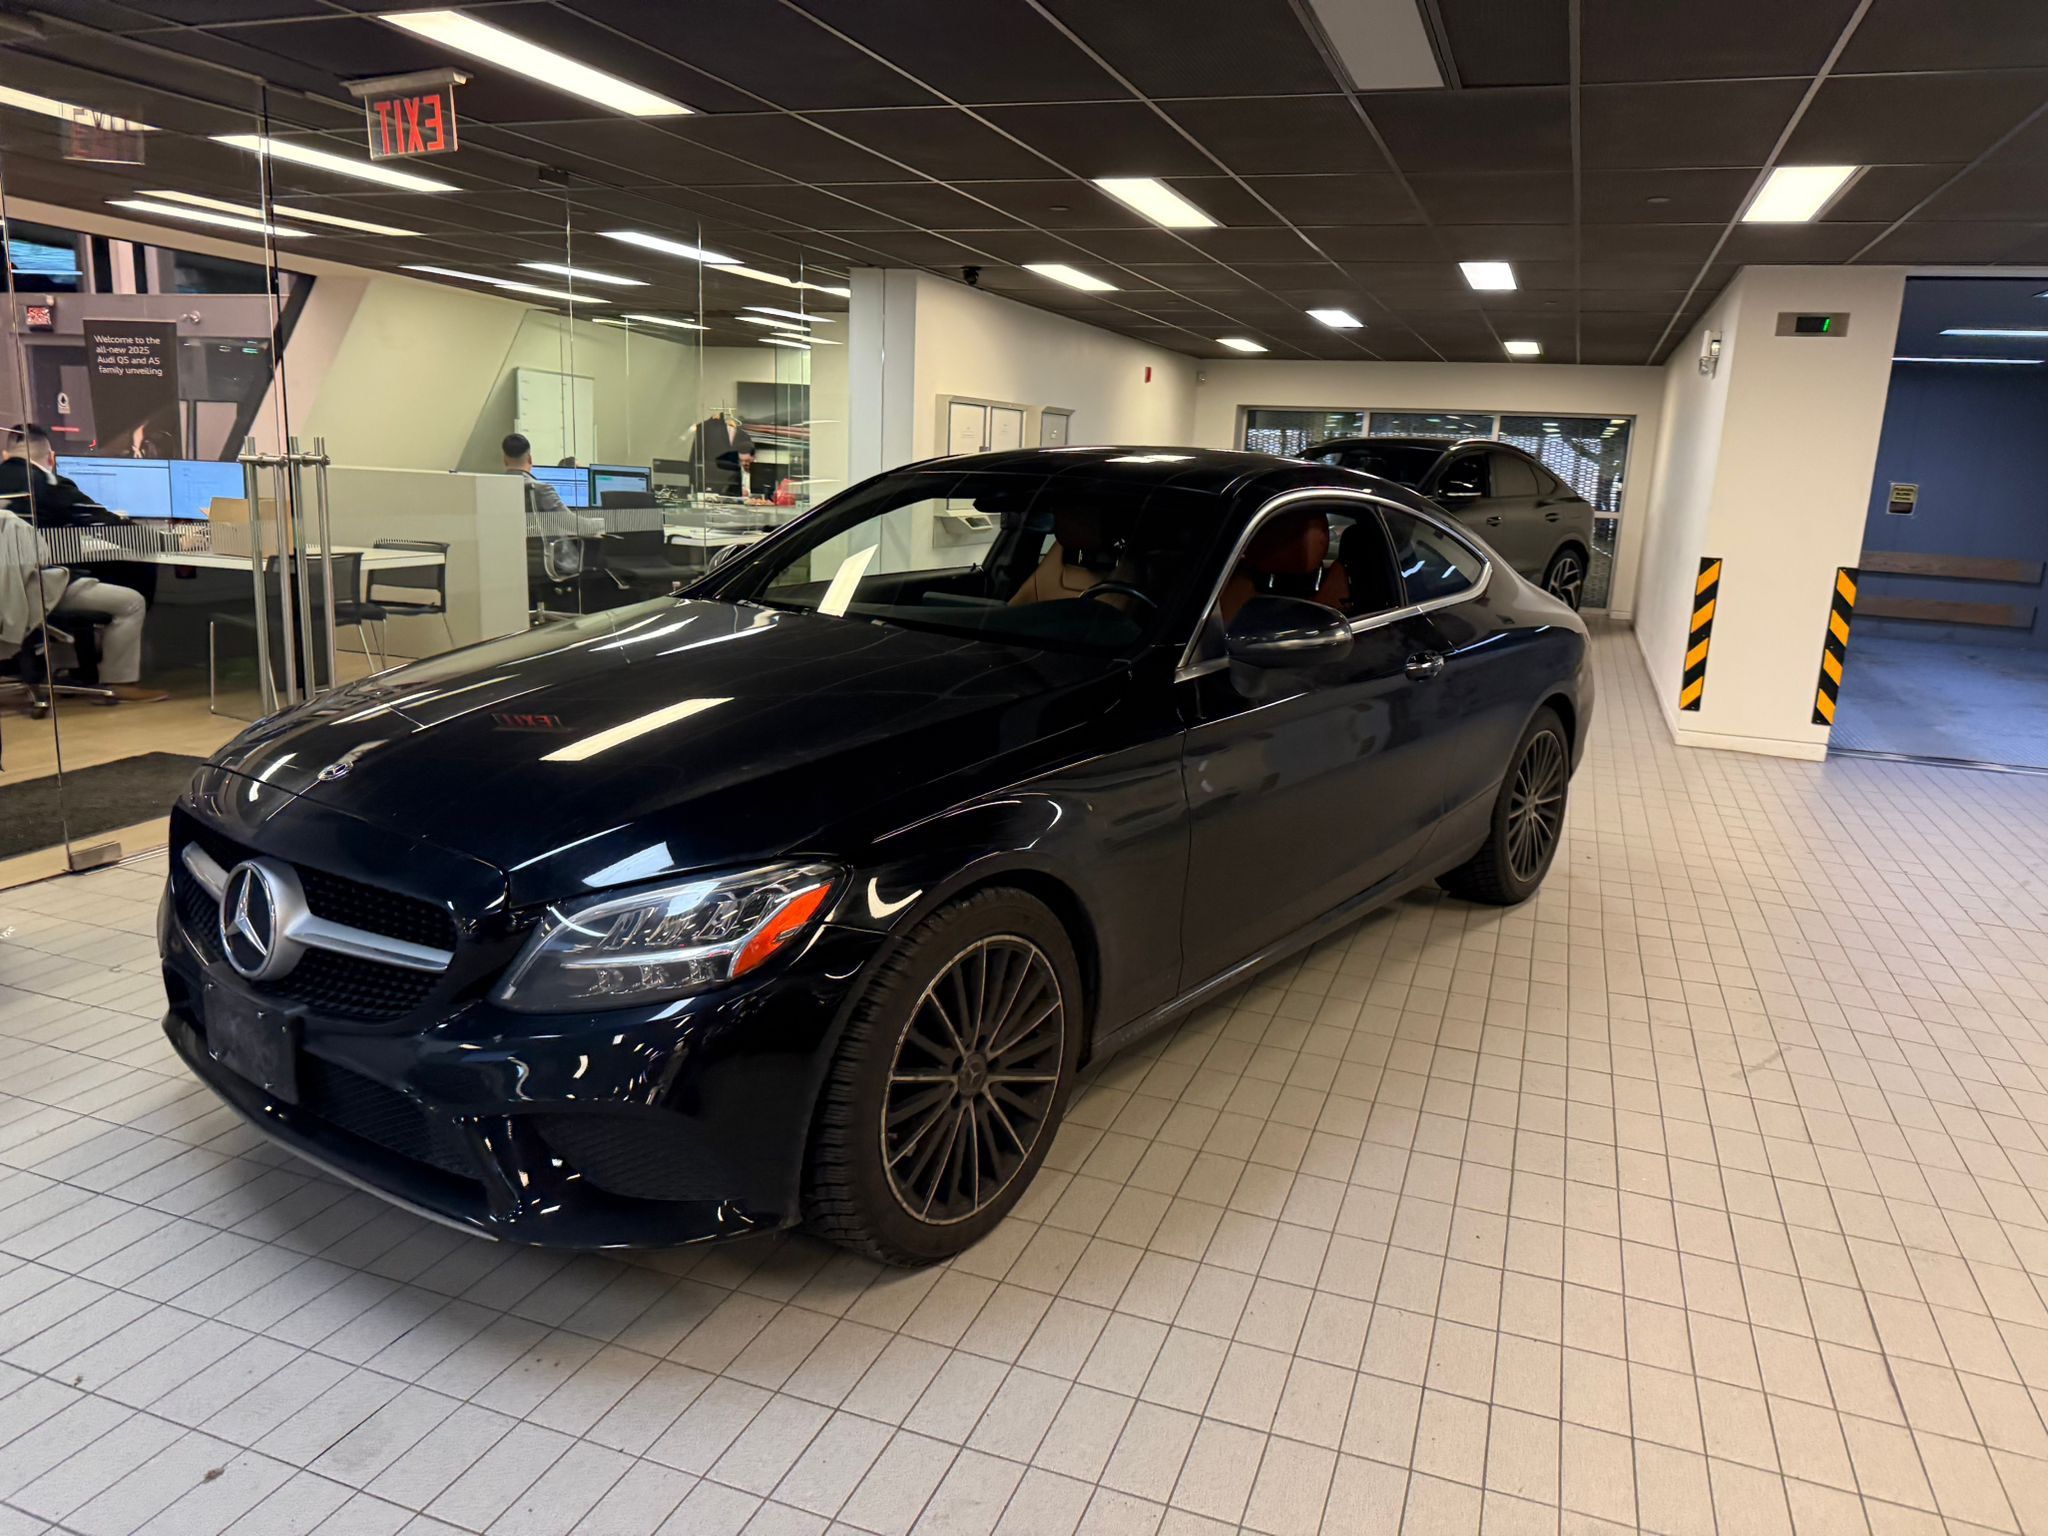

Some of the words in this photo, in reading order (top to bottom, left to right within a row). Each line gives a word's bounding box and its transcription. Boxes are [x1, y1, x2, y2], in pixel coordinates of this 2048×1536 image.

[94, 335, 133, 344] Welcome
[146, 337, 160, 345] the
[96, 346, 126, 354] all-new
[128, 346, 150, 354] 2025
[97, 356, 116, 364] Audi
[117, 357, 130, 365] Q5
[99, 366, 124, 376] family
[125, 367, 163, 376] unveiling
